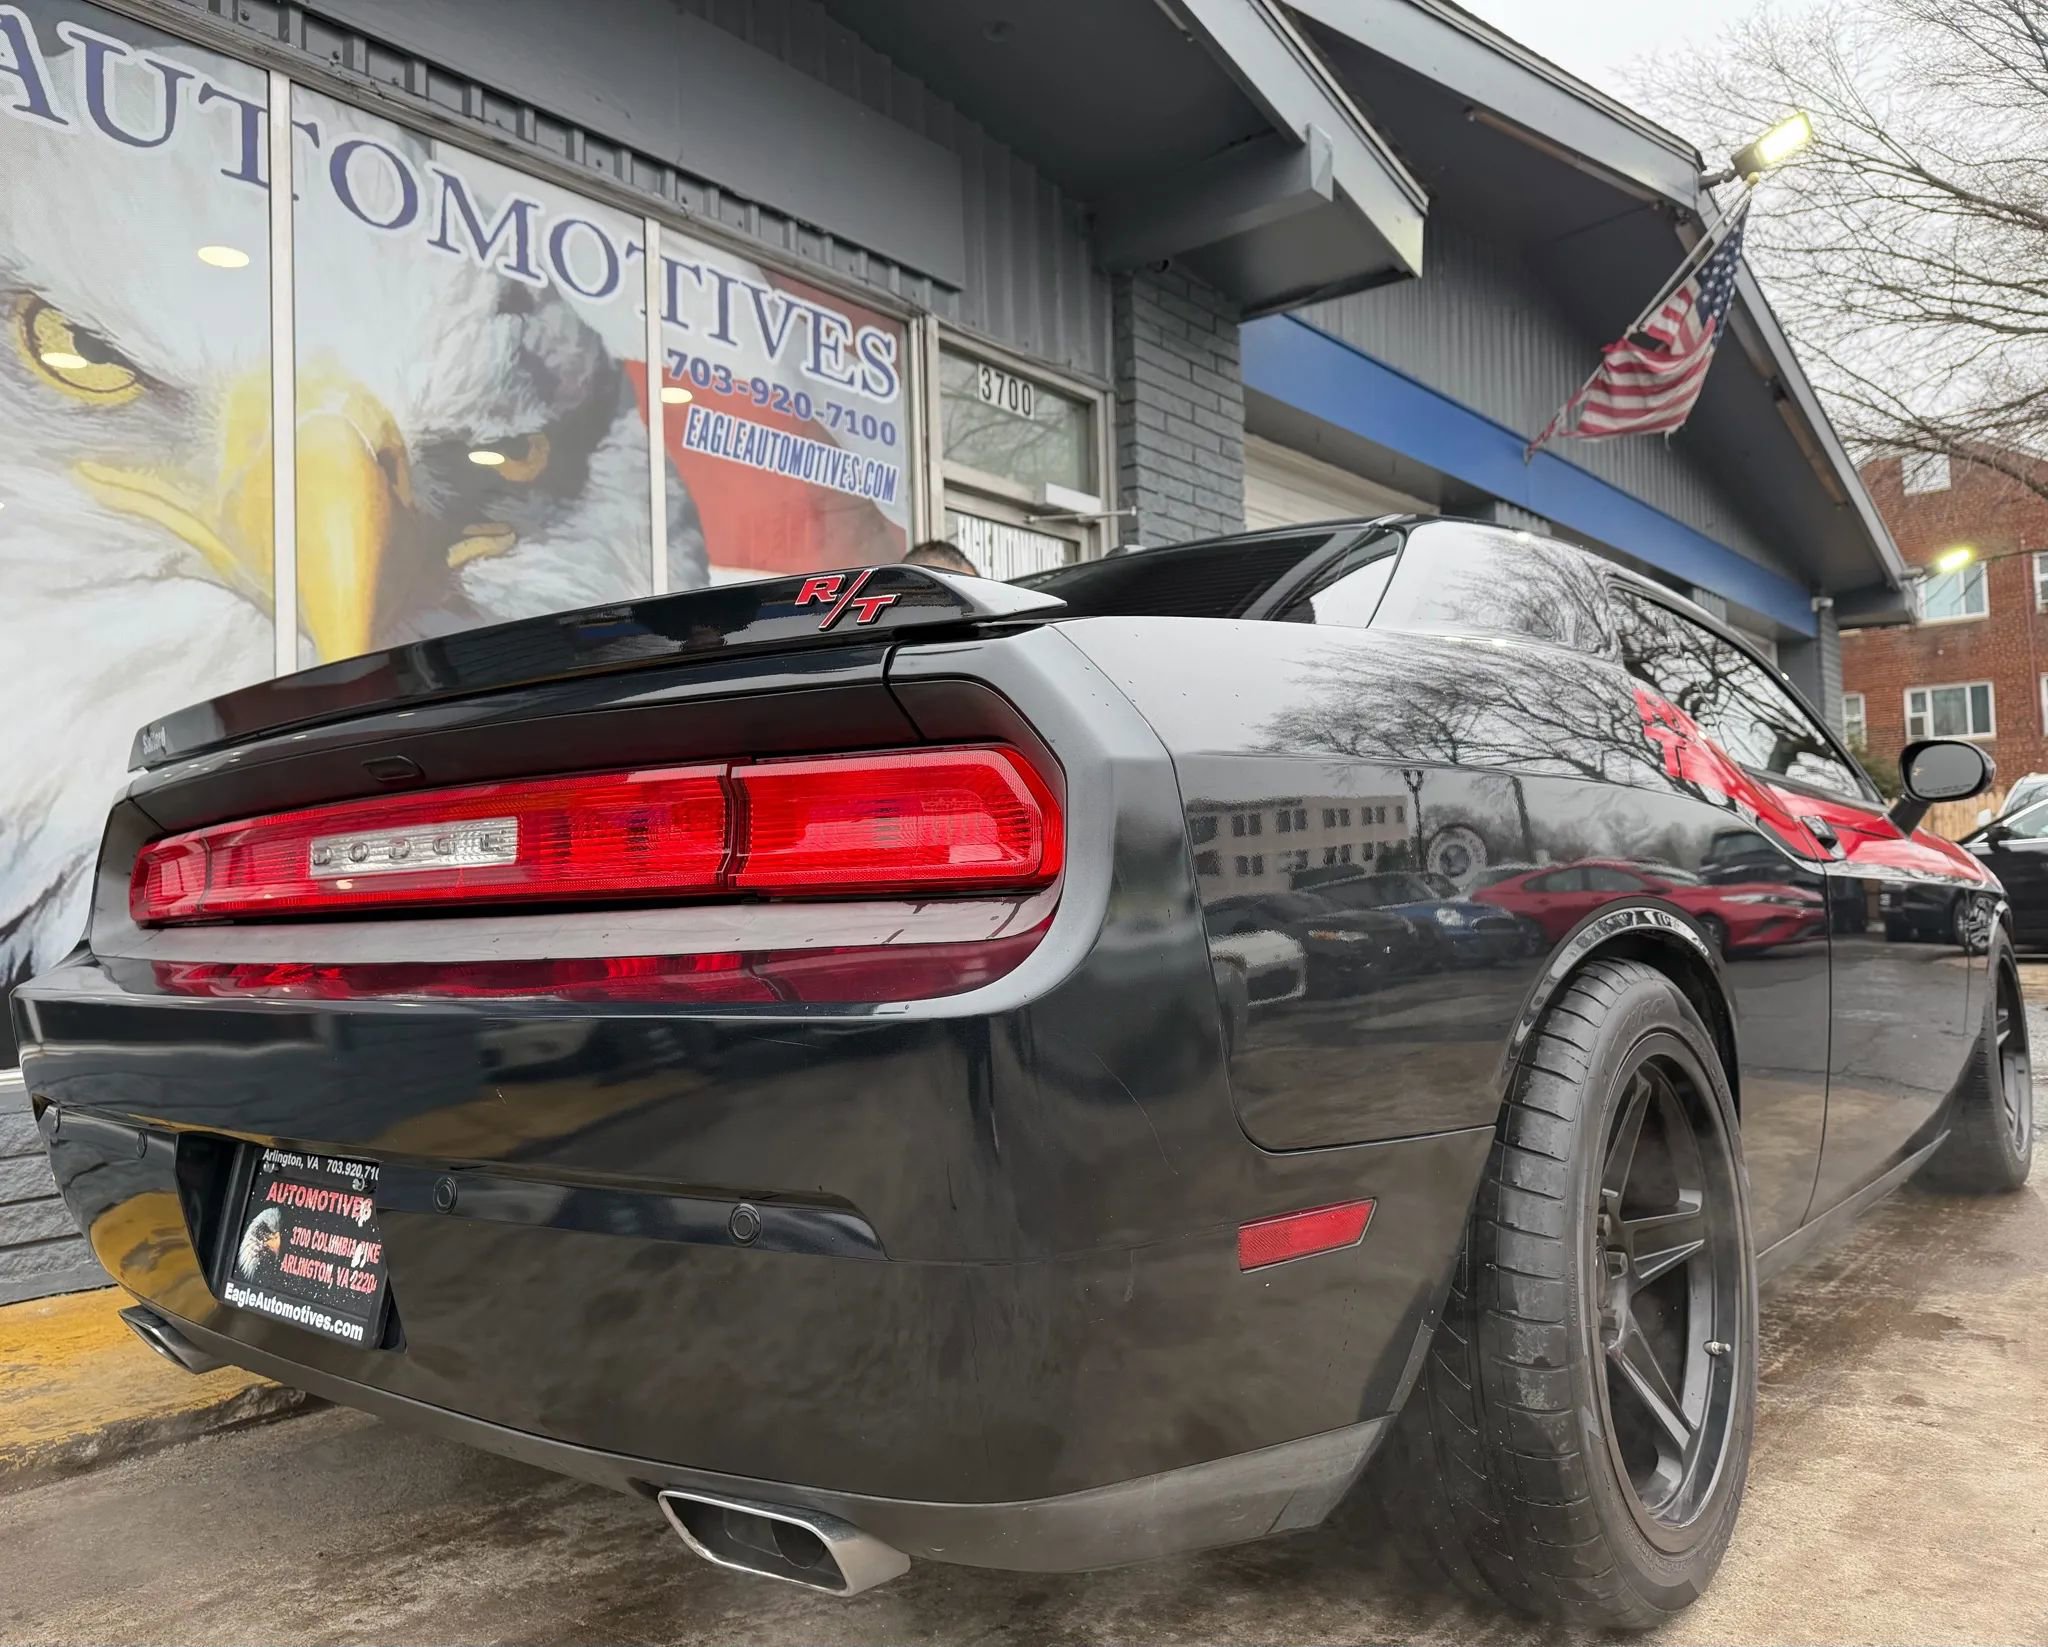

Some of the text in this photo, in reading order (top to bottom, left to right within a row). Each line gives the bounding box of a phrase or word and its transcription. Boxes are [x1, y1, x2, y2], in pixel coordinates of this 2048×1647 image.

[0, 12, 898, 397] AUTOMOTIVES
[667, 350, 897, 446] 703-920-7100
[981, 367, 1032, 416] 3700
[686, 407, 898, 502] EAGLEAUTOMOTIVES.COM
[795, 568, 900, 631] R/T
[313, 831, 503, 866] DODGE
[262, 1148, 304, 1169] Arlington,
[306, 1155, 319, 1170] VA
[266, 1181, 373, 1220] AUTOMOTIVES
[290, 1226, 312, 1248] 3700
[311, 1230, 357, 1259] COLUMBIA
[280, 1253, 334, 1288] ARLINGTON,
[336, 1266, 349, 1288] VA
[223, 1282, 364, 1341] EagleAutomotives.com
